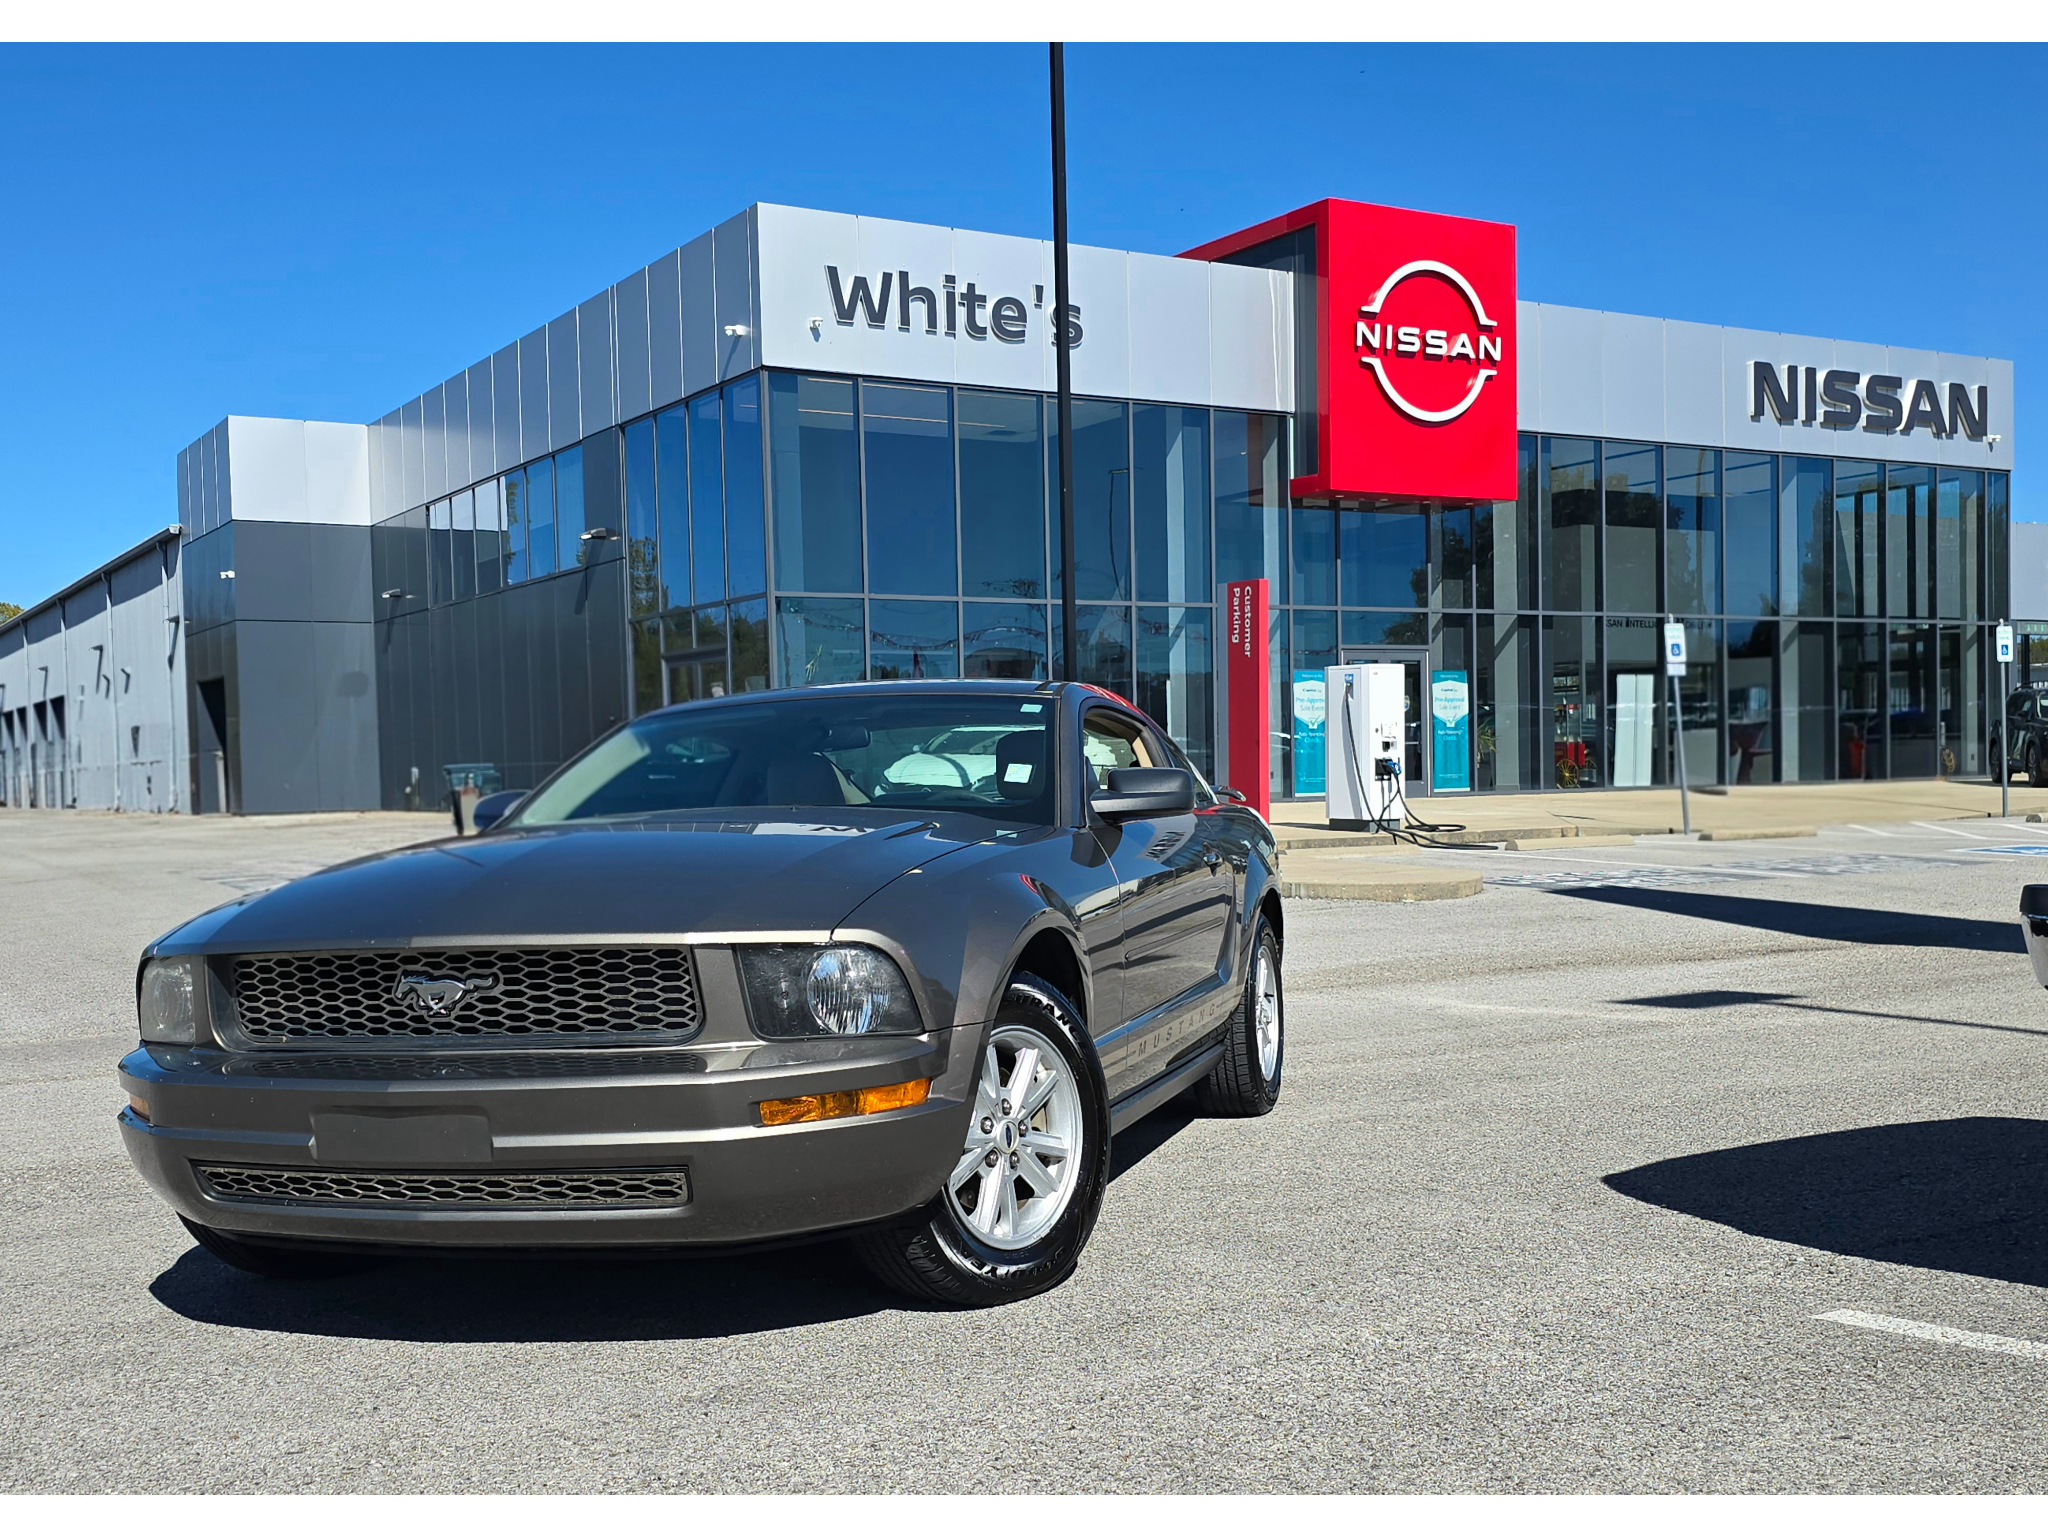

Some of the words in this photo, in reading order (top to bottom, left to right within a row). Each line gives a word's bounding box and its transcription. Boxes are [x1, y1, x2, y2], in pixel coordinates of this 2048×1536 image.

[823, 264, 1084, 348] White's
[1356, 320, 1502, 362] NISSAN
[1749, 360, 1988, 440] NISSAN
[1231, 587, 1241, 644] Parking
[1243, 585, 1252, 658] Customer
[1605, 618, 1623, 628] SAN
[1625, 617, 1657, 629] INTELLI
[1295, 696, 1325, 705] Pre-Approv
[1137, 1002, 1216, 1057] MUSTANG
